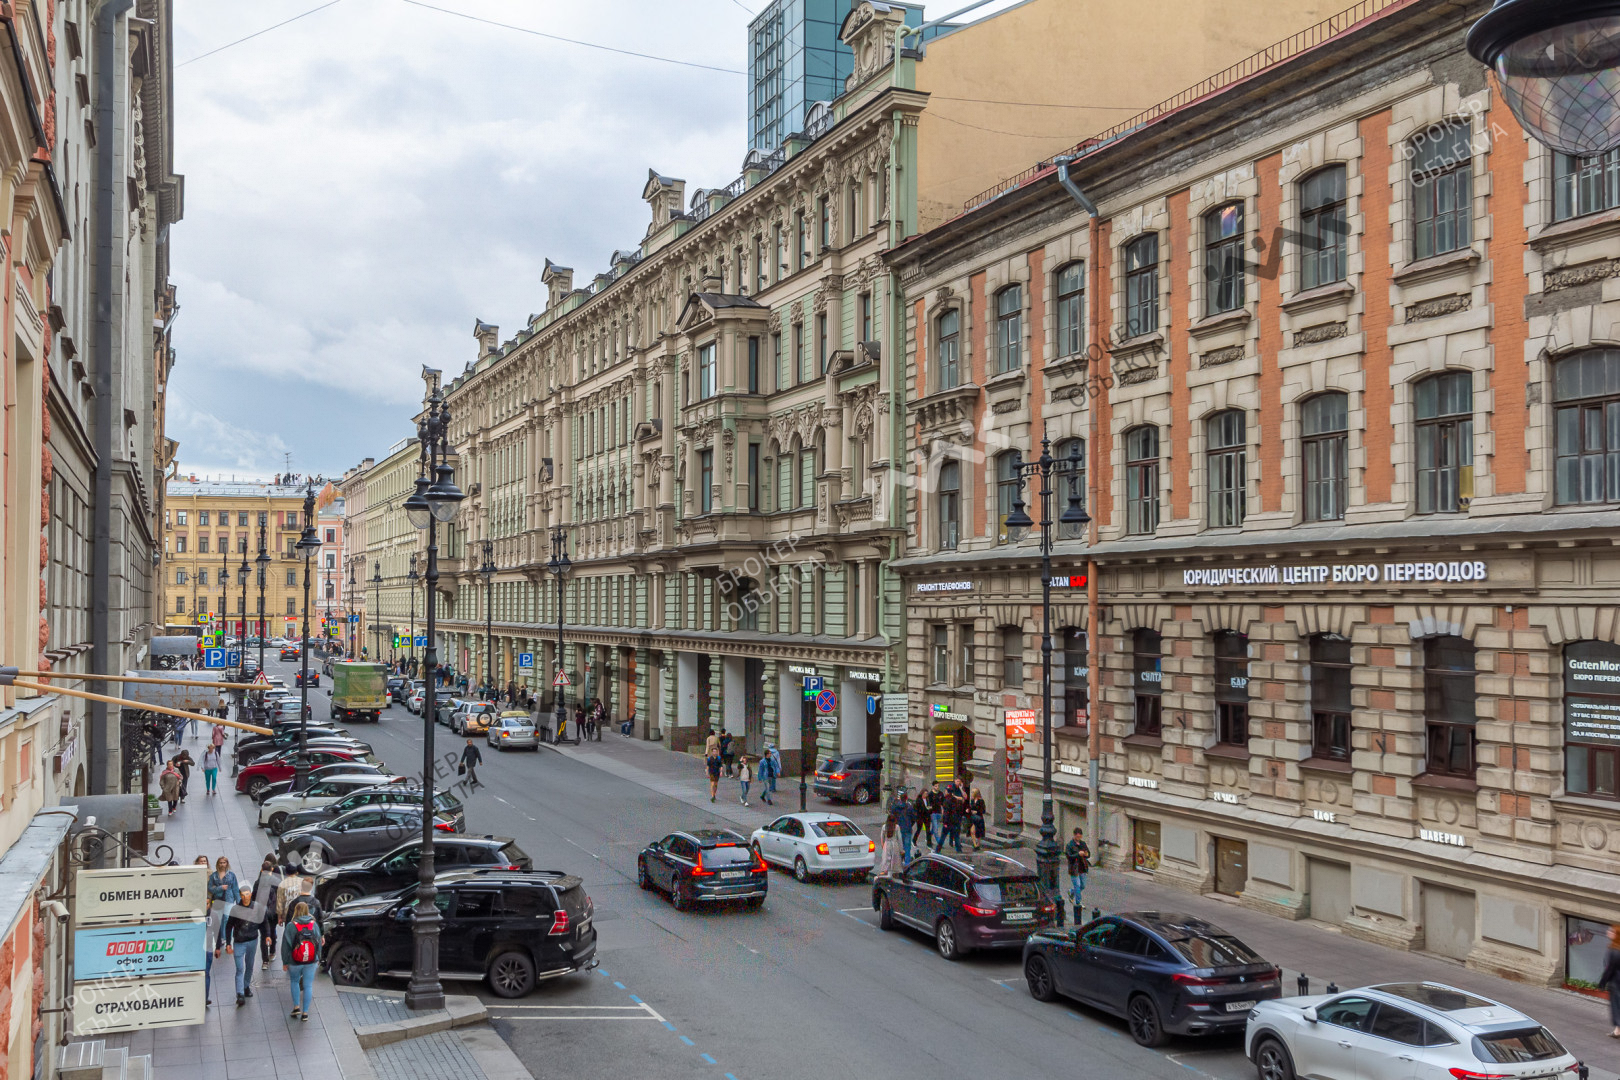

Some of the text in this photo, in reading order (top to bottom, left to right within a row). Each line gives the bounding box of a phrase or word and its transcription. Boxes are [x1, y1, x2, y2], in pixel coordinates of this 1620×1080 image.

[1183, 561, 1487, 586] ЮРИДИЧЕСКИЙ ЦЕНТР БЮРО ПЕРЕВОДОВ
[917, 581, 971, 592] РЕМОНТ ТЕЛЕФОНОВ
[1070, 576, 1087, 587] БАР
[211, 650, 222, 666] P
[523, 654, 531, 665] P
[1569, 659, 1620, 672] GutenMor
[1230, 677, 1247, 686] БАР
[1573, 673, 1594, 681] БЮРО
[810, 678, 818, 690] P
[1006, 710, 1029, 719] ПРОДУКТЫ
[1006, 717, 1035, 726] ШАВЕРМА
[1213, 791, 1239, 804] 24 ЧАСА
[1313, 809, 1336, 823] КАФЕ
[1420, 828, 1466, 847] ШАВЕРМА
[99, 887, 185, 903] ОБМЕН ВАЛЮТ
[107, 938, 175, 956] 1001ТУР
[116, 954, 165, 967] офис 202
[95, 996, 185, 1015] СТРАХОВАНИЕ
